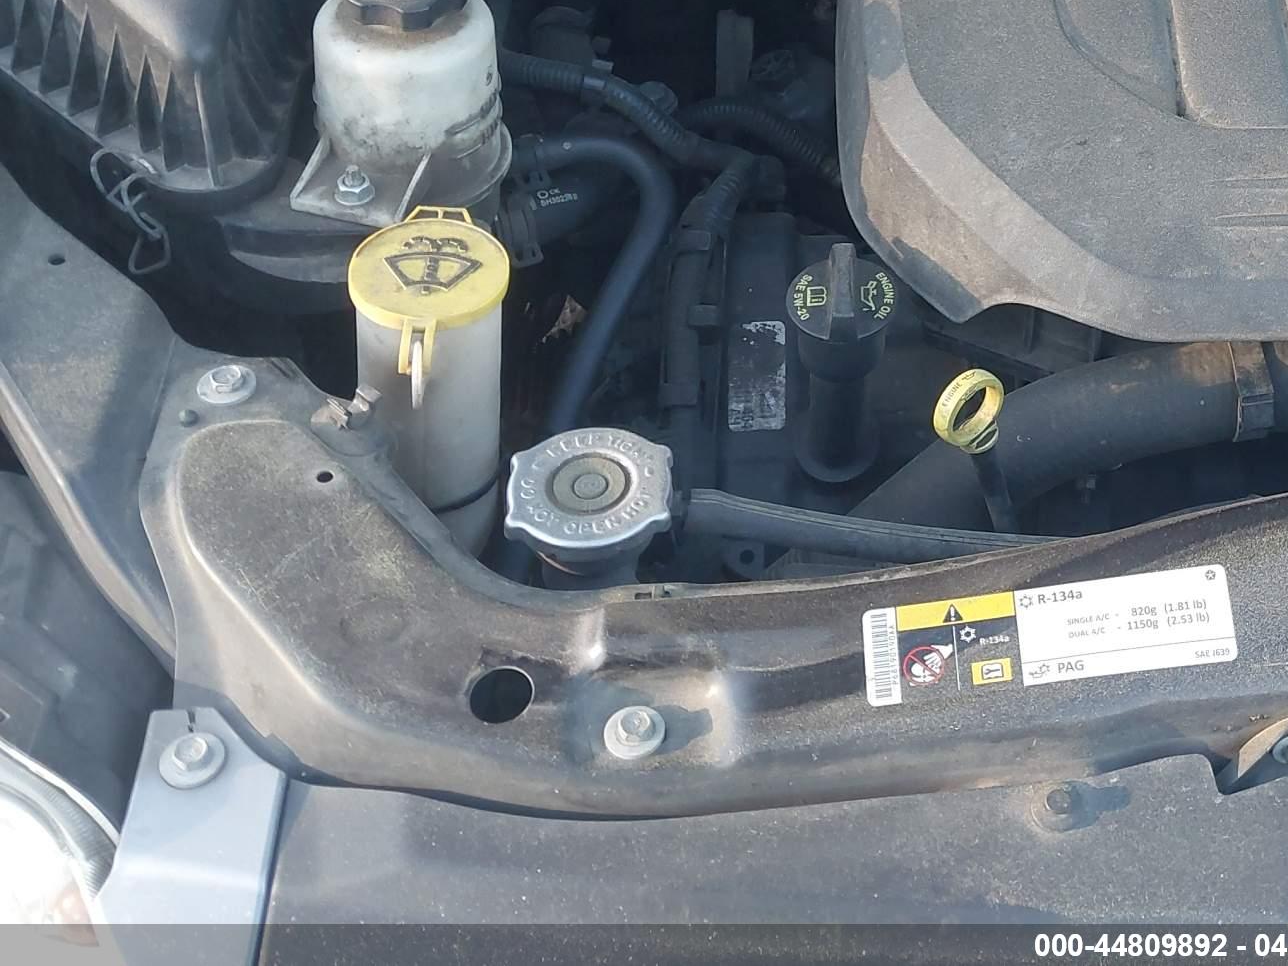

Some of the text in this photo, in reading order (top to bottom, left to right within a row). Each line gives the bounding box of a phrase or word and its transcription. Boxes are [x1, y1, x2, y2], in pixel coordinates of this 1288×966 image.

[793, 274, 813, 321] SAE 5W-20
[874, 272, 896, 321] ENGINE OIL
[564, 517, 621, 535] OPEN
[1037, 589, 1083, 605] R-134a
[1067, 616, 1093, 626] SINGLE
[1095, 613, 1110, 622] A/C
[1131, 605, 1157, 619] 820g
[1164, 601, 1188, 615] (1.81
[1191, 598, 1207, 614] lb)
[1068, 630, 1088, 638] DUAL
[1090, 627, 1105, 636] A/C
[1127, 618, 1159, 632] 1150g
[1167, 614, 1191, 628] (2.53
[1193, 611, 1210, 626] lb)
[980, 634, 1010, 646] R-134a
[1195, 647, 1230, 659] SAE J639
[1058, 659, 1085, 674] PAG
